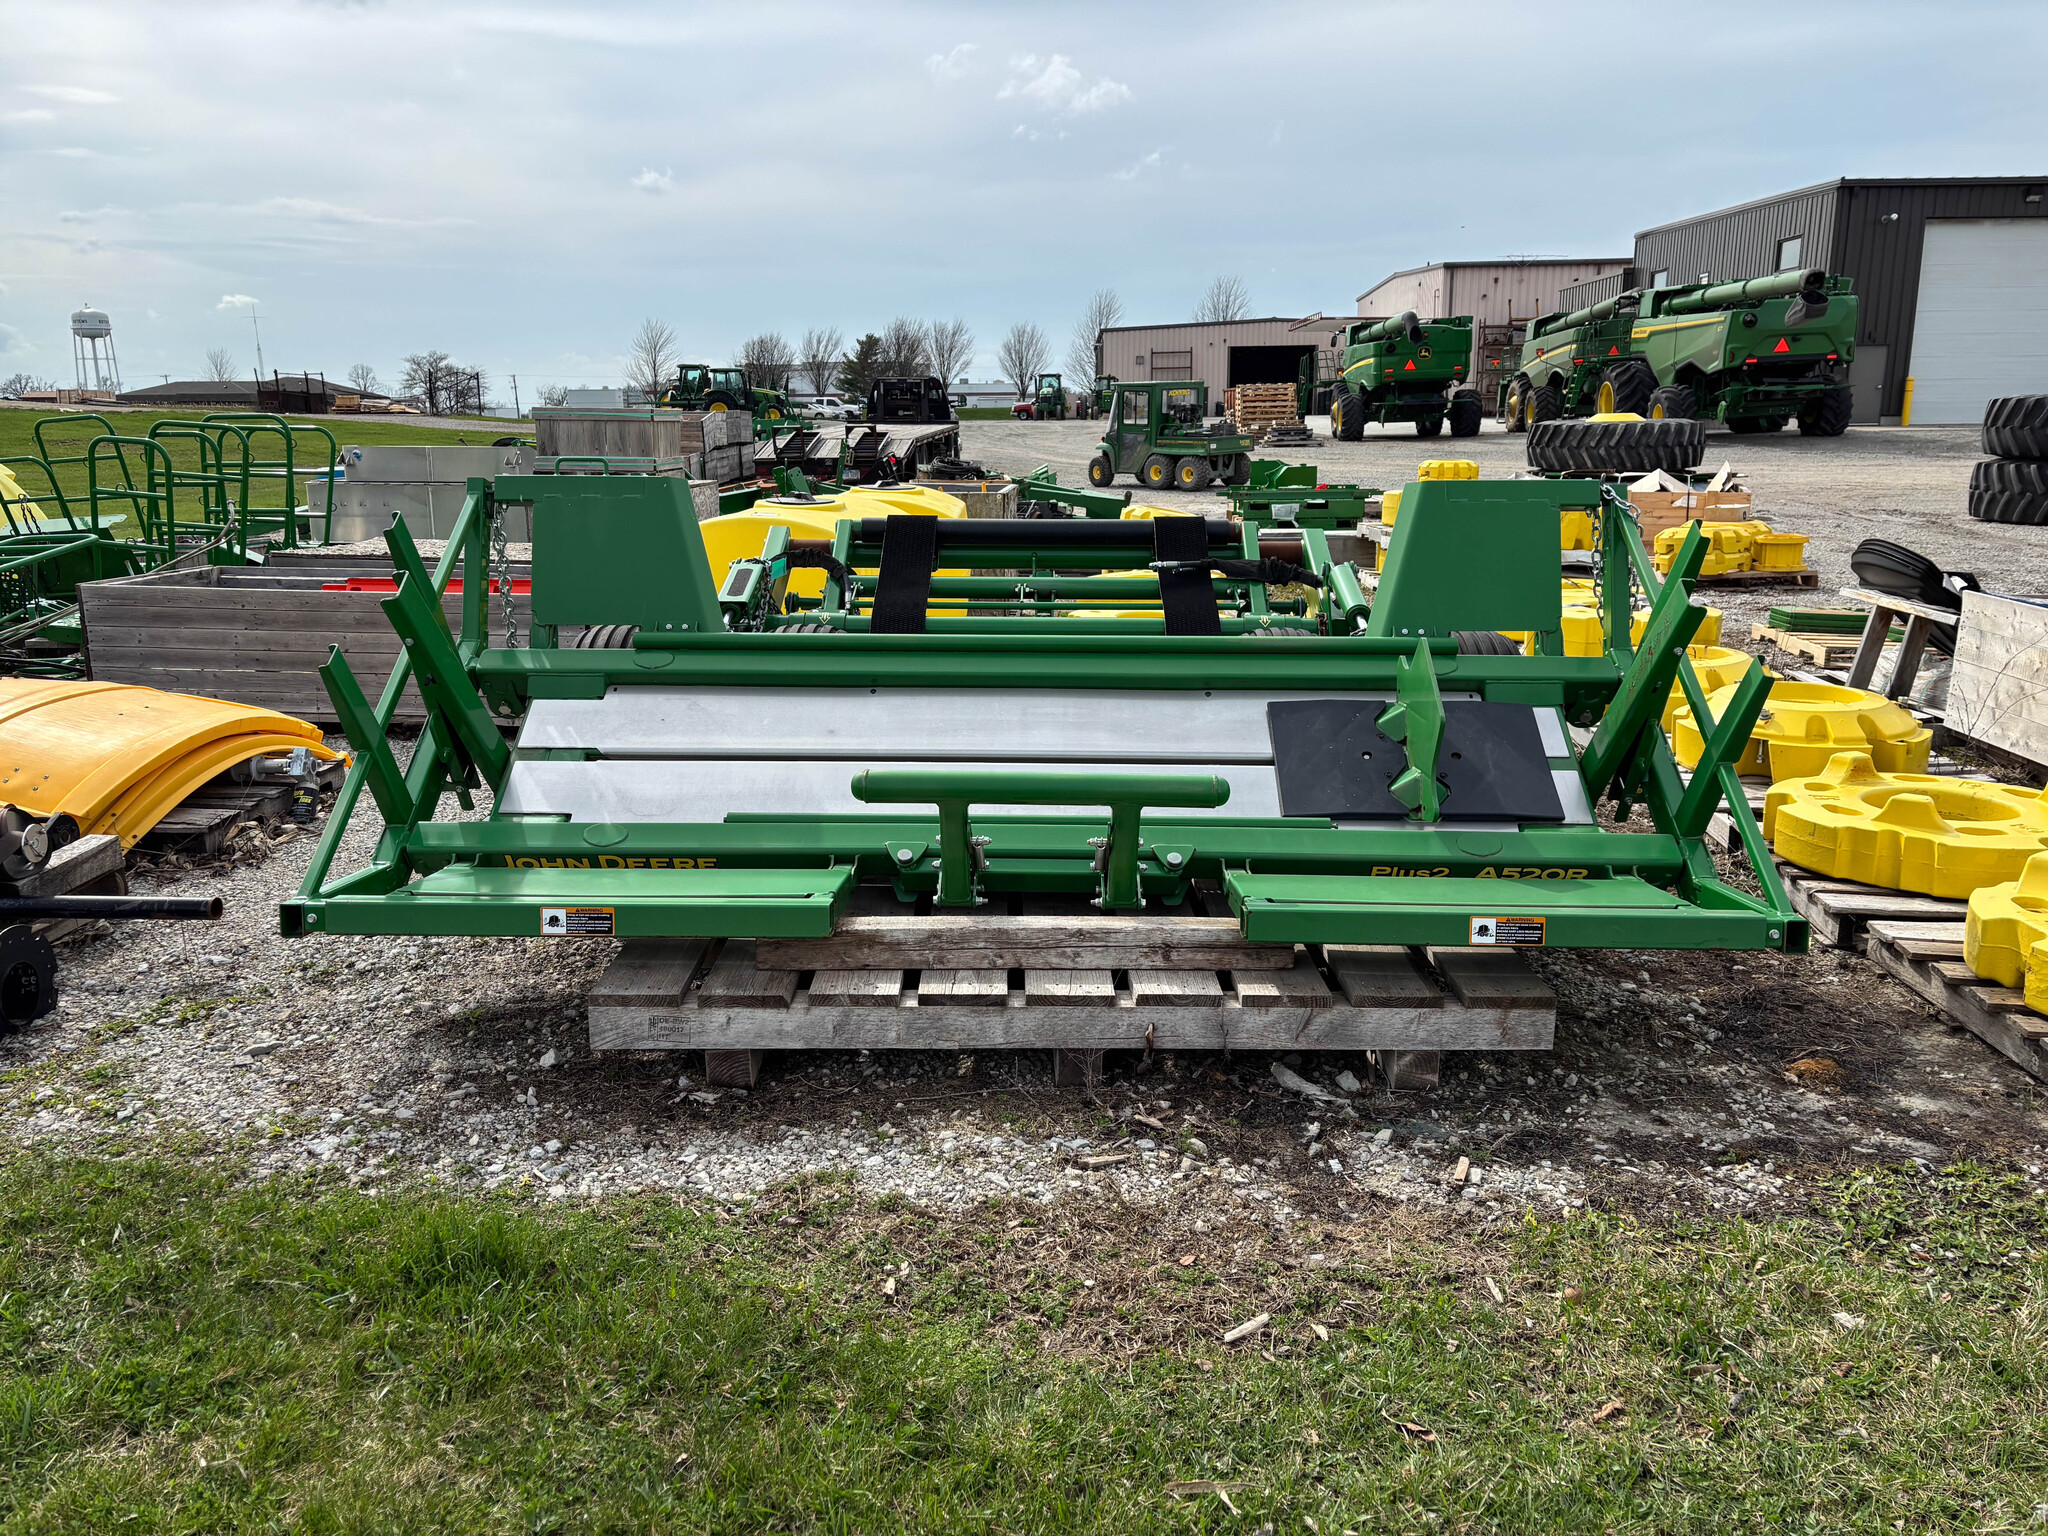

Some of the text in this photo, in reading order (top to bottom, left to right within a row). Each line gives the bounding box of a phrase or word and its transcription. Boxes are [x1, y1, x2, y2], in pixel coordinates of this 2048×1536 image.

[501, 855, 719, 869] JOHN DEERE
[1371, 866, 1589, 880] Plus2 A520R
